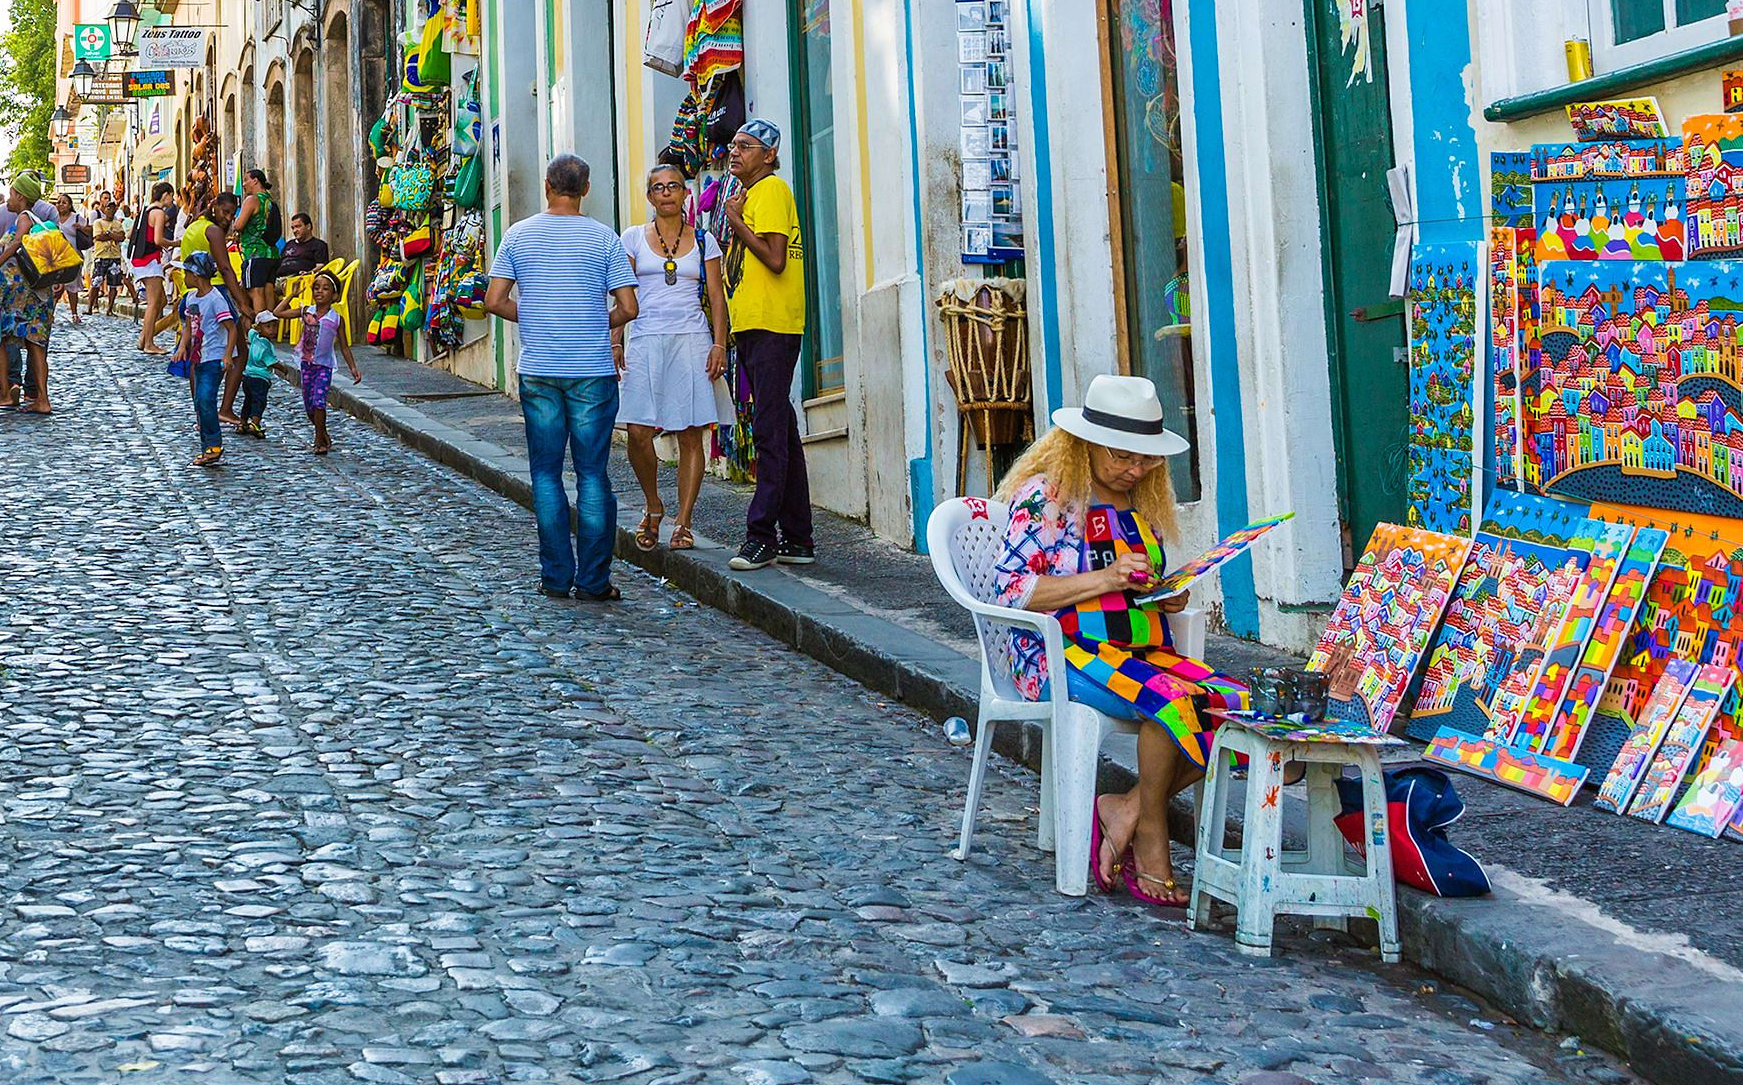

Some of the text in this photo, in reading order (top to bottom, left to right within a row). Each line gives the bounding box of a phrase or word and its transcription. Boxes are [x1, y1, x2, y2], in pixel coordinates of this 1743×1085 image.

[142, 29, 202, 39] Zeus Tattoo
[968, 499, 985, 512] 13
